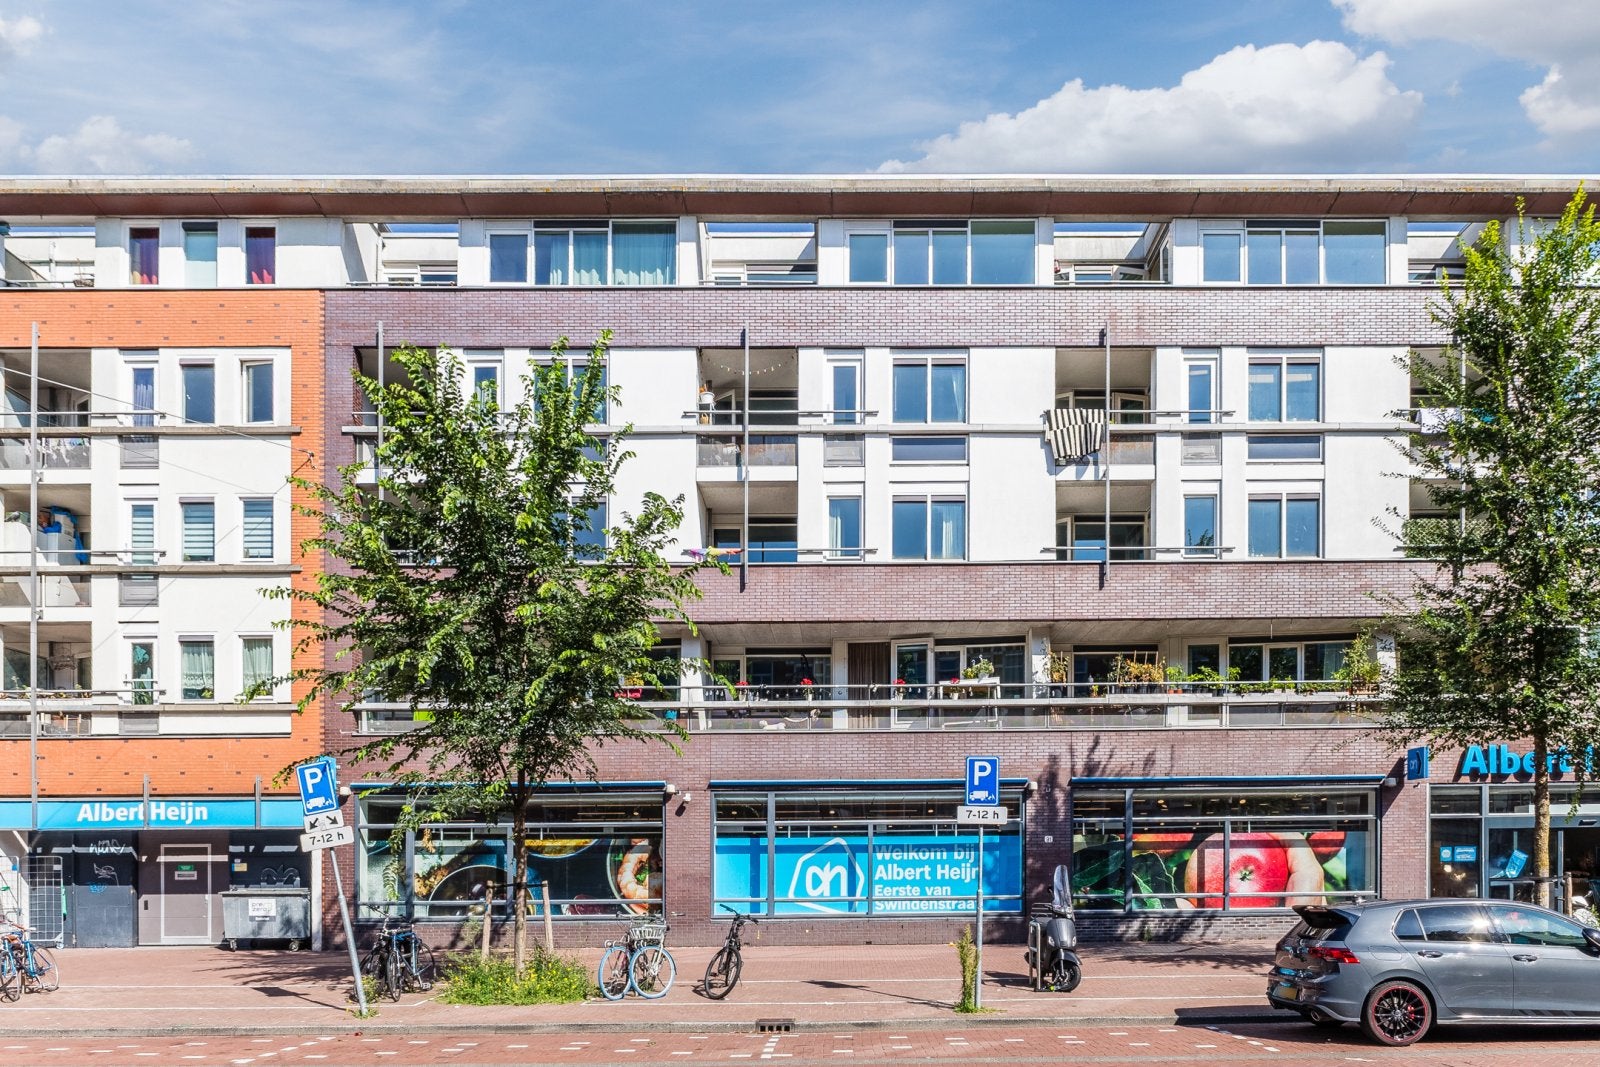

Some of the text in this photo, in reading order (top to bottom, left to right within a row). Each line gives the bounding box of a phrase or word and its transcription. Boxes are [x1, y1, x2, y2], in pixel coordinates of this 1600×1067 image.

[304, 767, 323, 794] P
[974, 761, 992, 786] P
[151, 802, 208, 825] Heijn
[966, 810, 999, 819] 7-12 h
[309, 832, 345, 846] 7-12 h
[875, 844, 975, 863] Welkom bij
[875, 864, 932, 881] Albert
[875, 885, 951, 897] Eerste van
[875, 900, 977, 911] Swindenstraa
